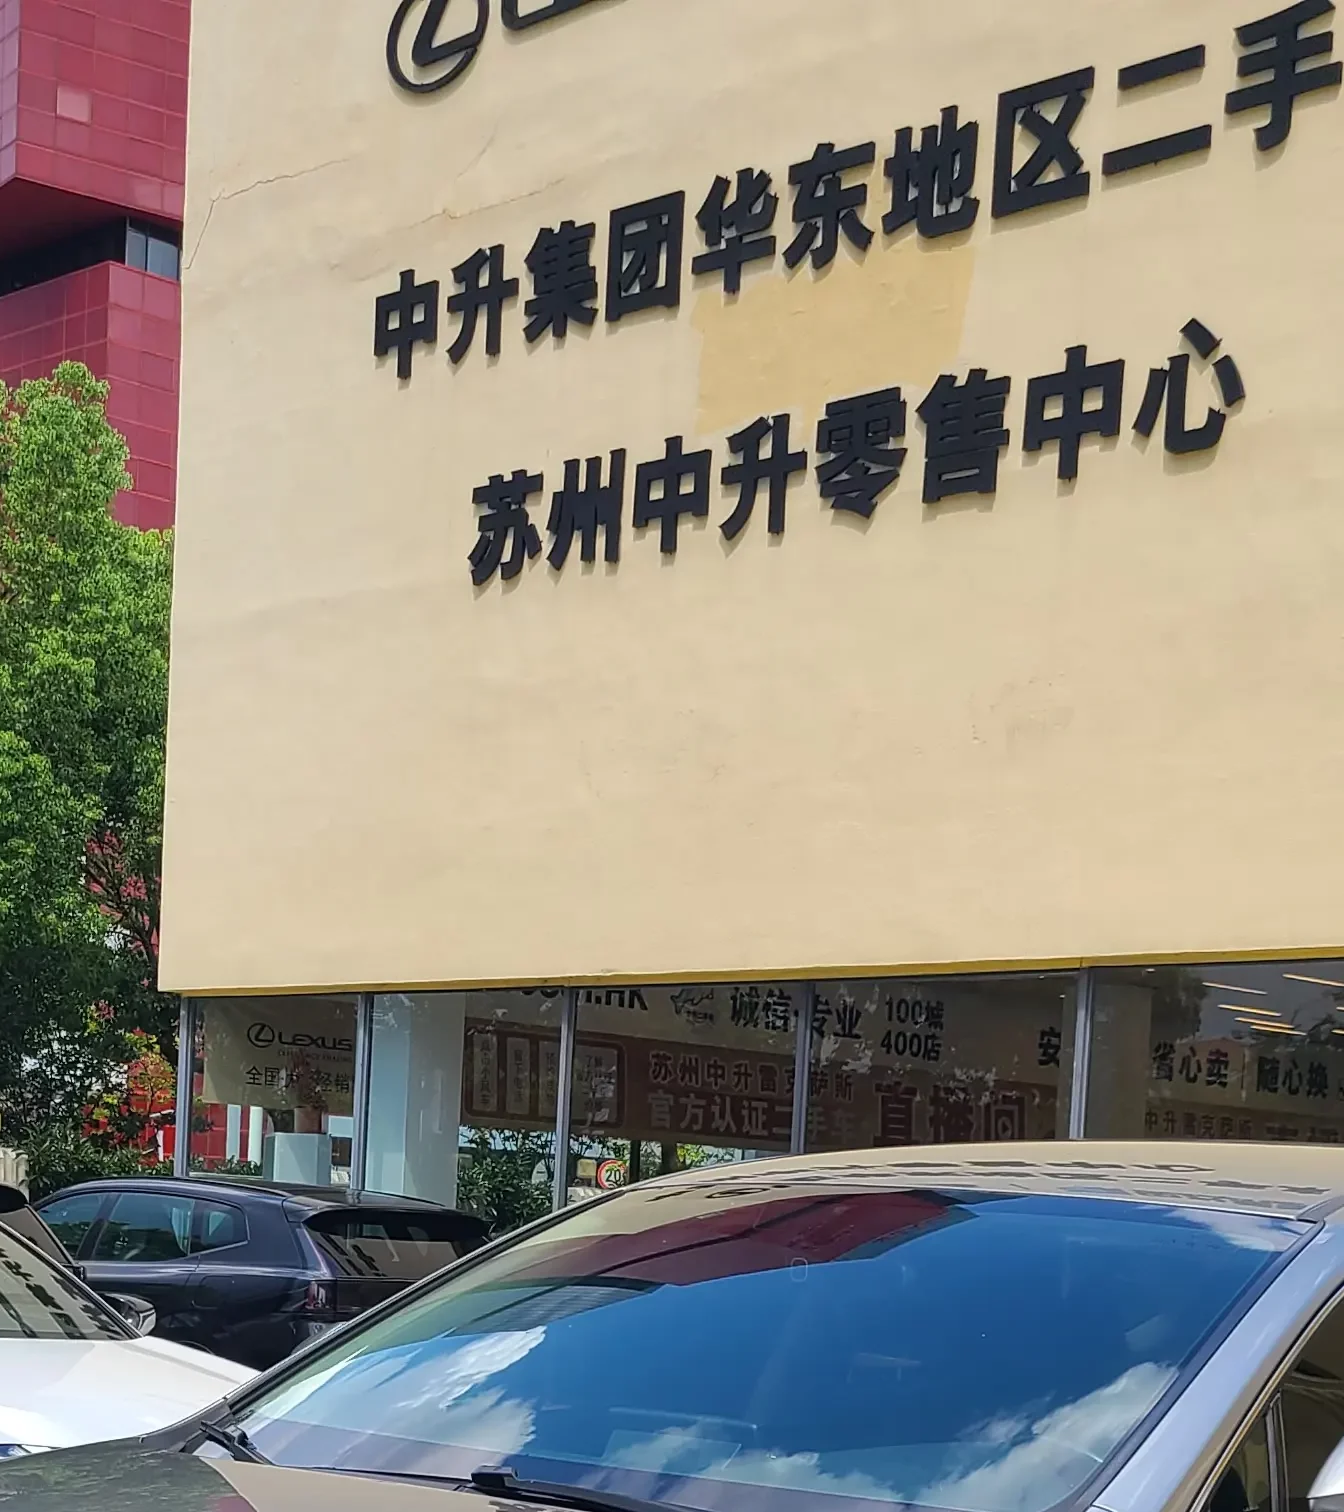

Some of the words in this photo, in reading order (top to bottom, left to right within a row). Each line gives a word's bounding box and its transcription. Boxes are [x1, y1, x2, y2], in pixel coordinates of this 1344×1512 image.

[468, 318, 1245, 586] 苏州中升零售中心
[278, 1030, 353, 1052] LEXUS
[880, 1029, 942, 1062] 400店
